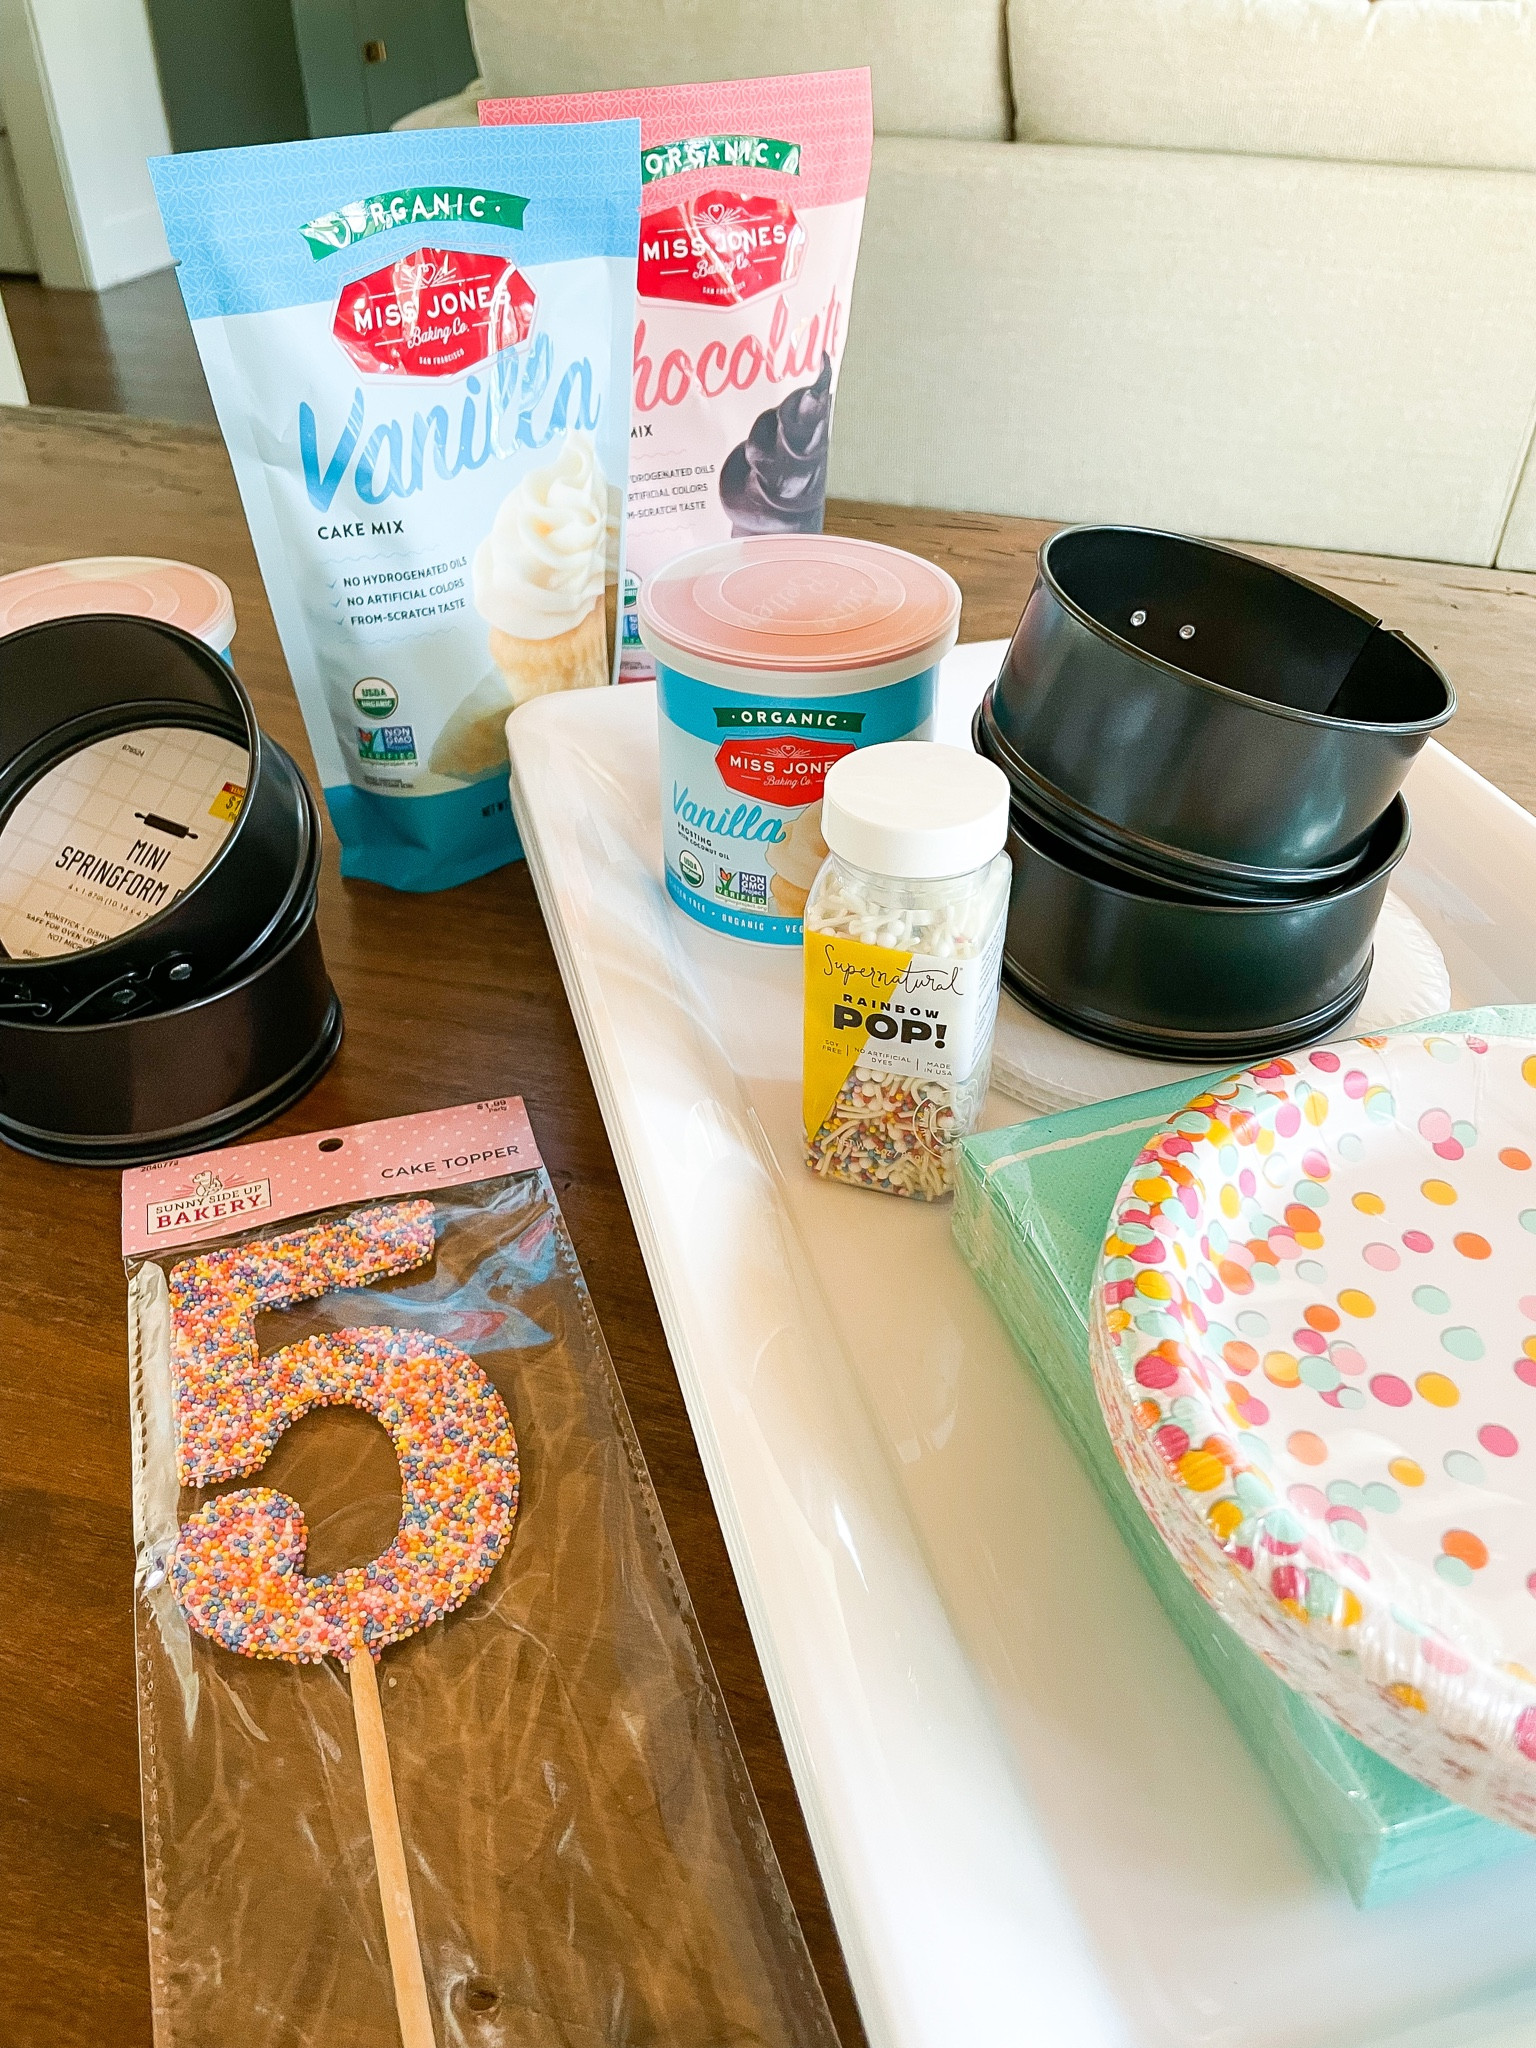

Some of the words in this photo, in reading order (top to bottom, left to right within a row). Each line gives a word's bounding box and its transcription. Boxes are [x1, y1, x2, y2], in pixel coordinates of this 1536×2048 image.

[645, 140, 769, 175] ORGANIC
[642, 237, 706, 262] MISS
[715, 224, 786, 254] JONES
[353, 300, 419, 332] MISS
[408, 323, 453, 350] Baking
[695, 464, 715, 475] OILS
[628, 486, 671, 501] RTIFICIAL
[672, 482, 709, 496] COLORS
[679, 500, 707, 511] TASTE
[317, 522, 366, 540] CAKE
[371, 520, 404, 535] MIX
[343, 576, 361, 588] NO
[364, 563, 449, 586] HYDROGENATED
[449, 556, 468, 570] OILS
[347, 596, 364, 607] NO
[367, 588, 427, 606] ARTIFICIAL
[429, 578, 465, 597] COLORS
[350, 606, 436, 626] FROM-SCRATCH
[438, 598, 466, 615] TASTE
[741, 711, 838, 727] ORGANIC
[385, 728, 411, 738] NON
[386, 736, 413, 745] GMO
[730, 755, 775, 773] MISS
[783, 761, 835, 775] JONE
[763, 775, 799, 789] Baking
[673, 780, 787, 843] Vanilla
[677, 821, 712, 847] FROSTING
[126, 839, 172, 873] MINI
[690, 838, 718, 856] COCONUT
[718, 852, 731, 861] OIL
[683, 857, 698, 871] USDA
[55, 846, 170, 906] SPRINGFORM
[741, 874, 765, 884] NON
[741, 880, 765, 890] GMO
[718, 887, 766, 904] VERIFIED
[741, 888, 765, 897] Project
[26, 913, 44, 926] SAFE
[45, 920, 61, 932] FOR
[61, 927, 81, 940] OVEN
[44, 910, 80, 931] NONSTICK
[87, 928, 112, 941] DISHW
[47, 932, 62, 944] NOT
[823, 944, 964, 996] Supernatural
[843, 994, 940, 1019] RAINBOW
[833, 1003, 947, 1049] POP!
[822, 1045, 842, 1054] FREE
[867, 1050, 912, 1063] ARTIFICIAL
[871, 1058, 893, 1067] DYES
[927, 1061, 951, 1070] MADE
[936, 1069, 953, 1077] USA
[381, 1161, 437, 1179] CAKE
[442, 1145, 520, 1169] TOPPER
[156, 1198, 206, 1214] SUNNY
[208, 1190, 240, 1204] SIDE
[243, 1184, 262, 1195] UP
[156, 1194, 262, 1229] BAKERY
[169, 1198, 519, 1664] 5
